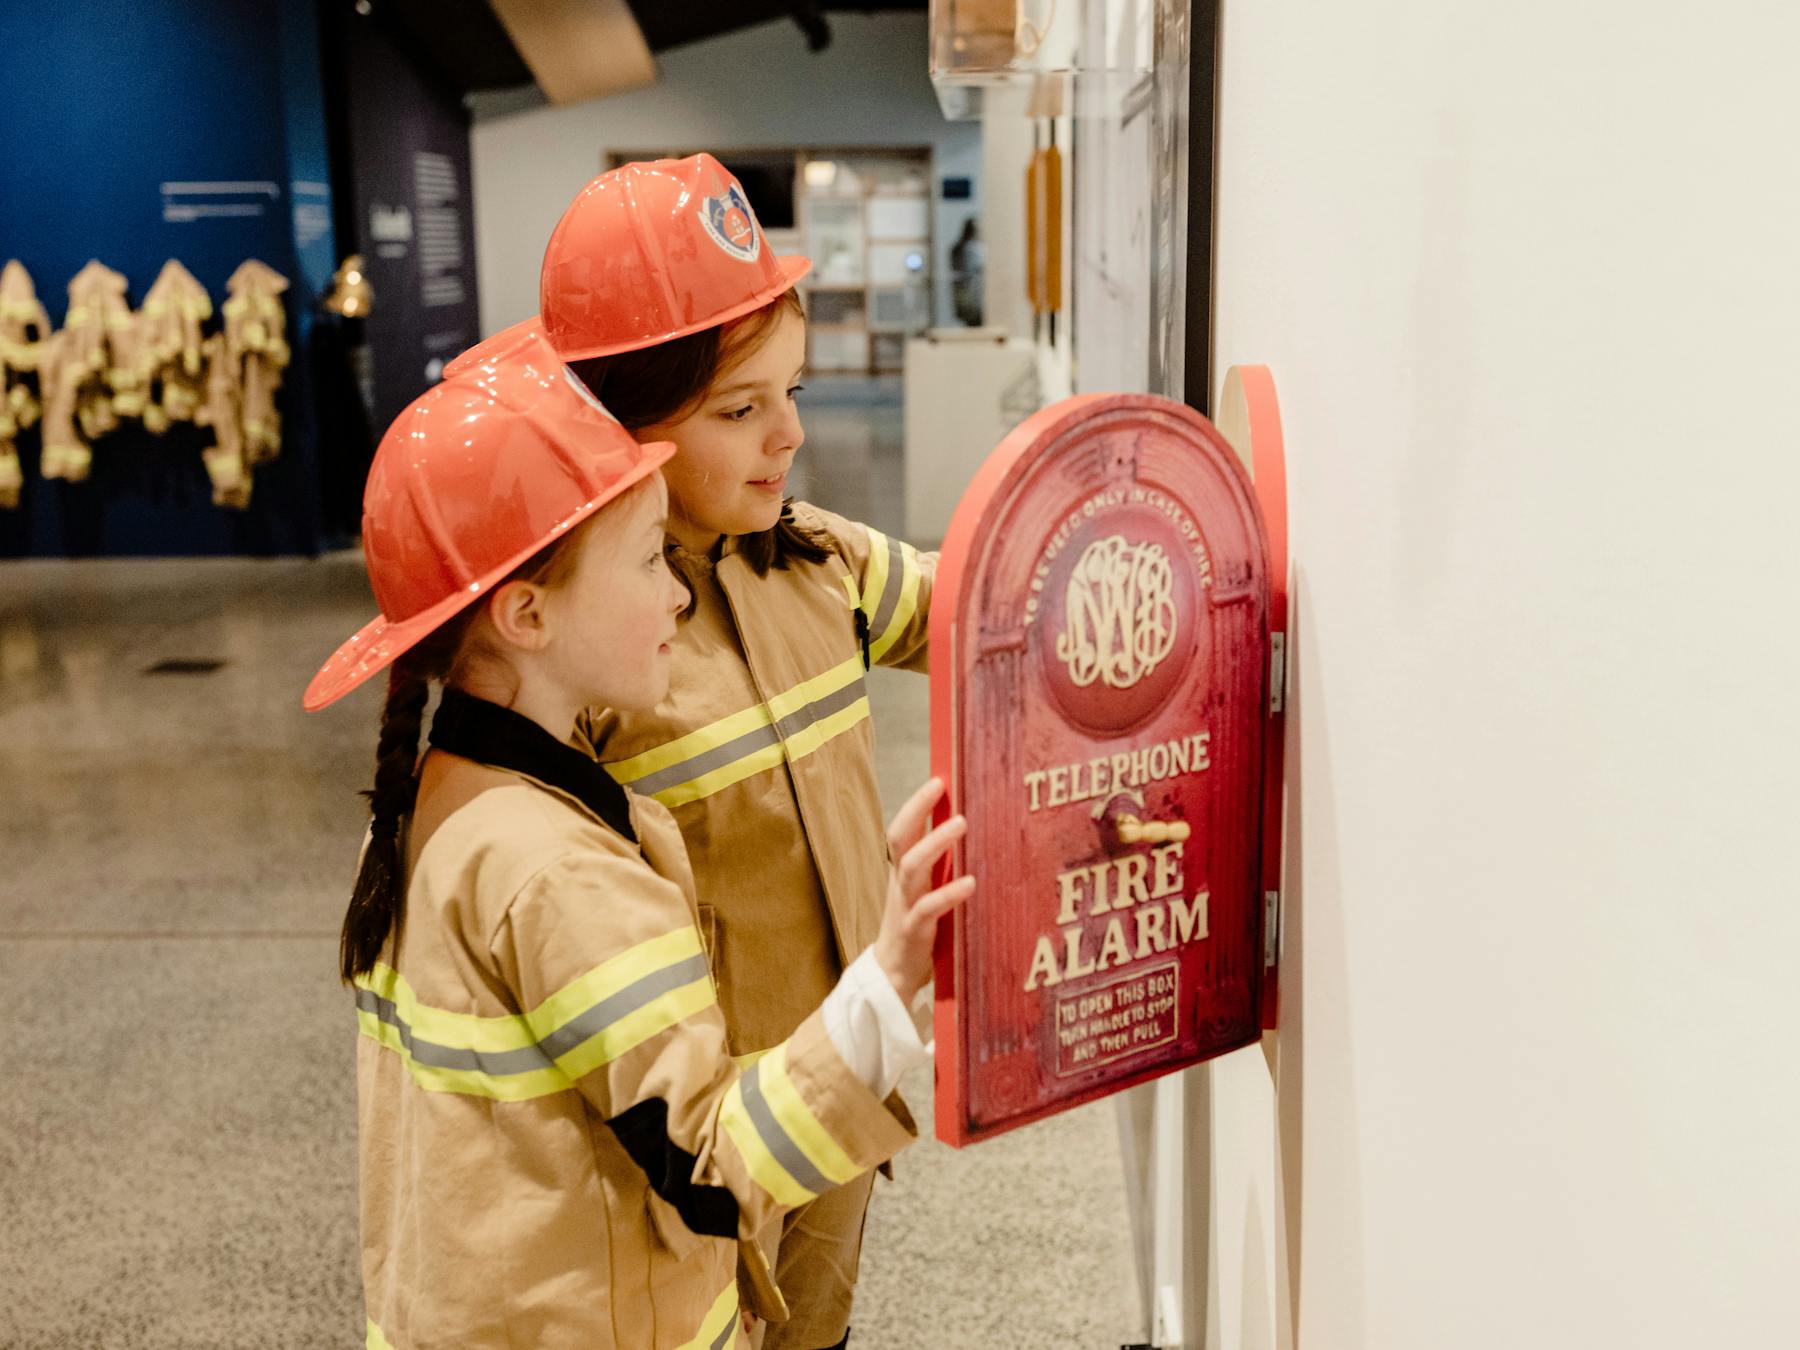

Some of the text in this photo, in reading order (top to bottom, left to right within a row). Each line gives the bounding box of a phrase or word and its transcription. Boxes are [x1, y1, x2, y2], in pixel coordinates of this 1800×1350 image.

[1083, 489, 1127, 517] ONLY
[1132, 489, 1146, 502] IN
[1147, 491, 1182, 524] CASE
[1182, 519, 1199, 541] OF
[1193, 544, 1213, 590] FIRE
[1024, 732, 1211, 811] TELEPHONE
[1056, 843, 1185, 925] FIRE
[1024, 891, 1210, 992] ALARM
[1060, 996, 1174, 1046] TURN HANDLE TO STOP
[1061, 973, 1174, 1024] TO OPEN THIS BOX
[1073, 1021, 1161, 1063] AND THEN PULL
